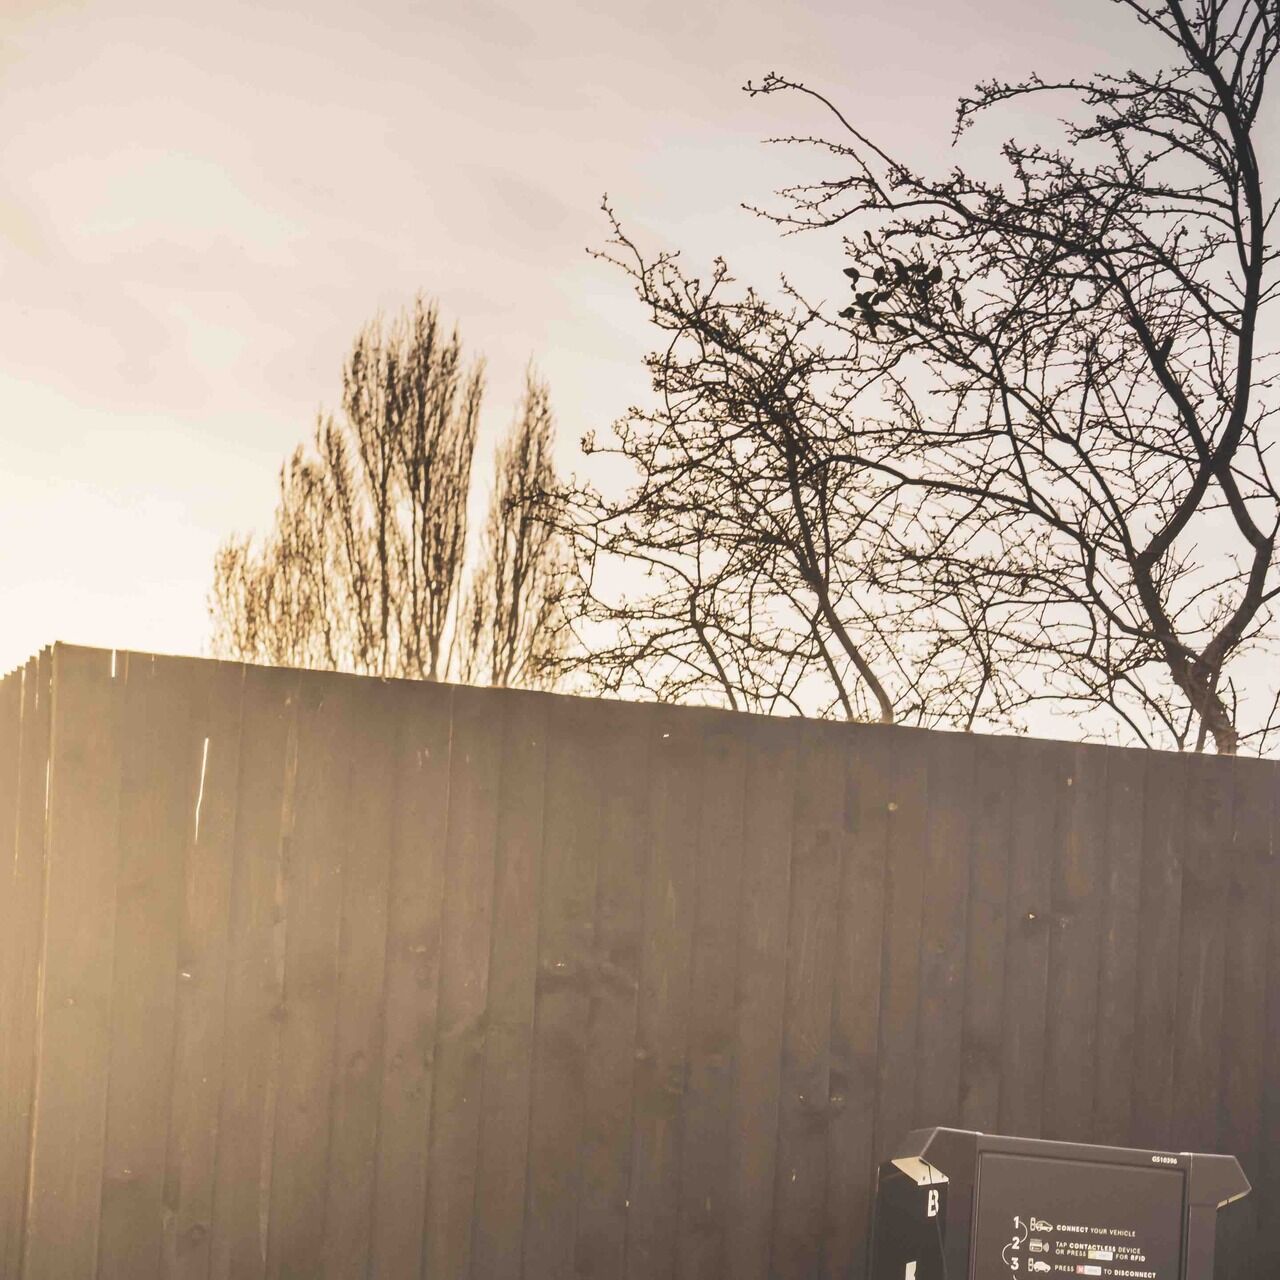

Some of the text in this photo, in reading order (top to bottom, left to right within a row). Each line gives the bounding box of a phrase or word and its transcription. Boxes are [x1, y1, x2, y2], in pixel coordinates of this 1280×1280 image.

[927, 1189, 939, 1217] B
[1013, 1216, 1020, 1229] 1
[1056, 1225, 1089, 1233] CONNECT
[1109, 1229, 1136, 1238] VEHICLE
[1011, 1236, 1020, 1250] 2
[1069, 1242, 1116, 1253] CONTACTLESS
[1118, 1246, 1141, 1255] DEVICE
[1010, 1257, 1020, 1271] 3
[1054, 1264, 1075, 1273] PRESS
[1114, 1269, 1157, 1279] DISCONNECT
[1130, 1254, 1146, 1262] RFID
